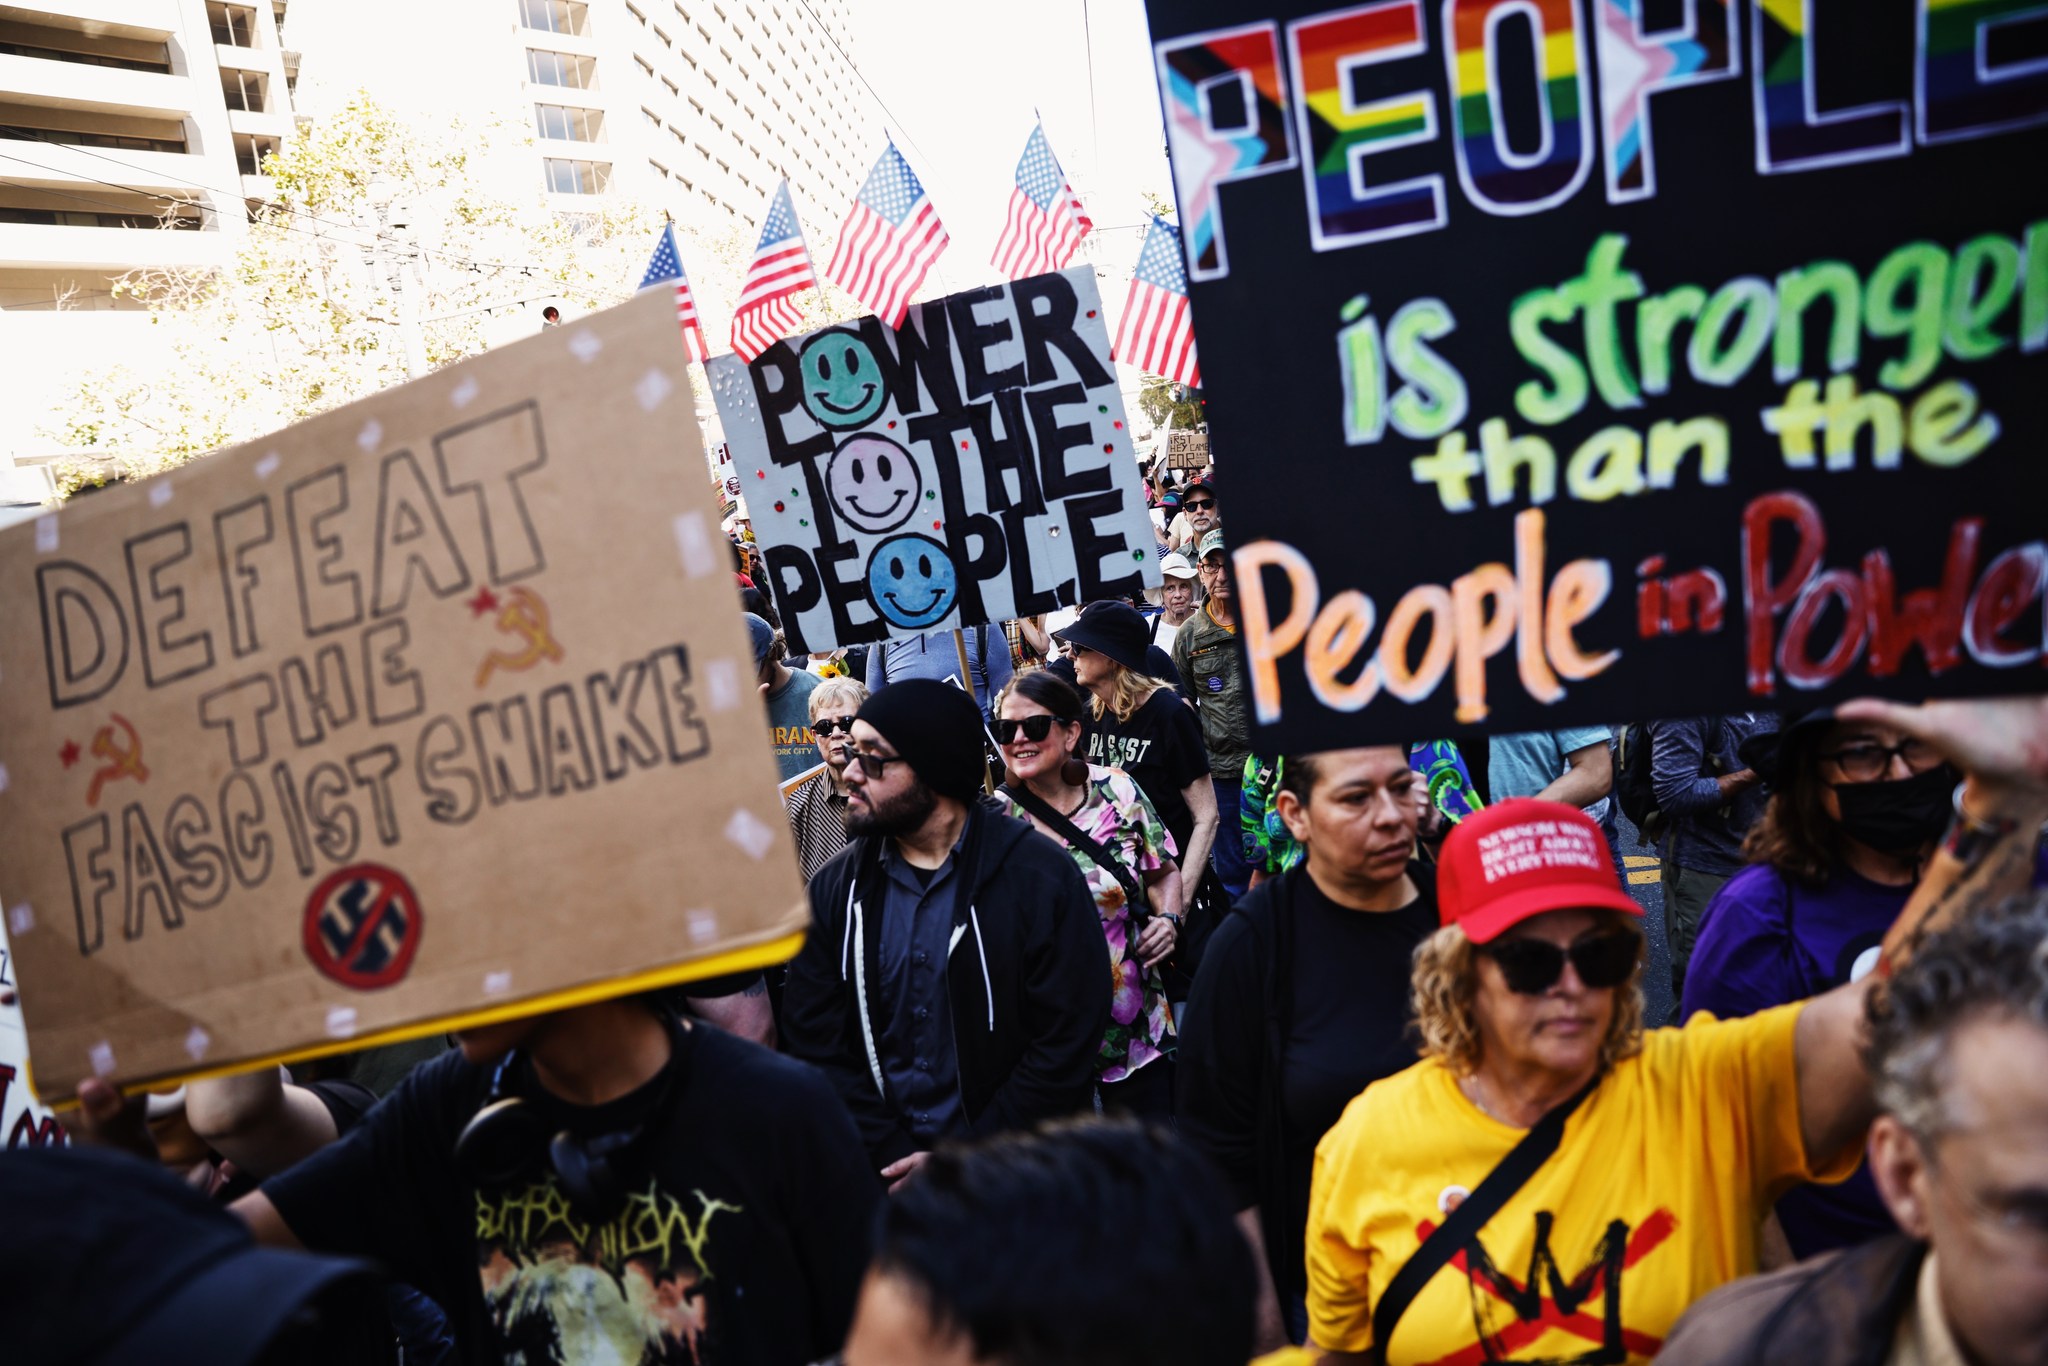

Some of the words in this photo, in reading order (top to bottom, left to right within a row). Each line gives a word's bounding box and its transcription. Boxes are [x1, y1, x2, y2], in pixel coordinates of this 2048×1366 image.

[748, 272, 1115, 464] POWER
[1337, 293, 1469, 447] is
[1411, 416, 1730, 512] than
[1761, 374, 2000, 471] the
[780, 430, 922, 550] TO
[907, 382, 1113, 523] THE
[1168, 453, 1196, 468] FOR
[36, 398, 548, 710] DEFEAT
[763, 489, 1148, 656] PEOPLE
[1232, 506, 1622, 726] People
[1636, 553, 1728, 639] in
[1741, 490, 2048, 698] Powe
[199, 616, 426, 769] THE
[793, 747, 813, 755] CITY
[61, 744, 402, 957] FASCIST
[416, 643, 712, 825] SNAKE
